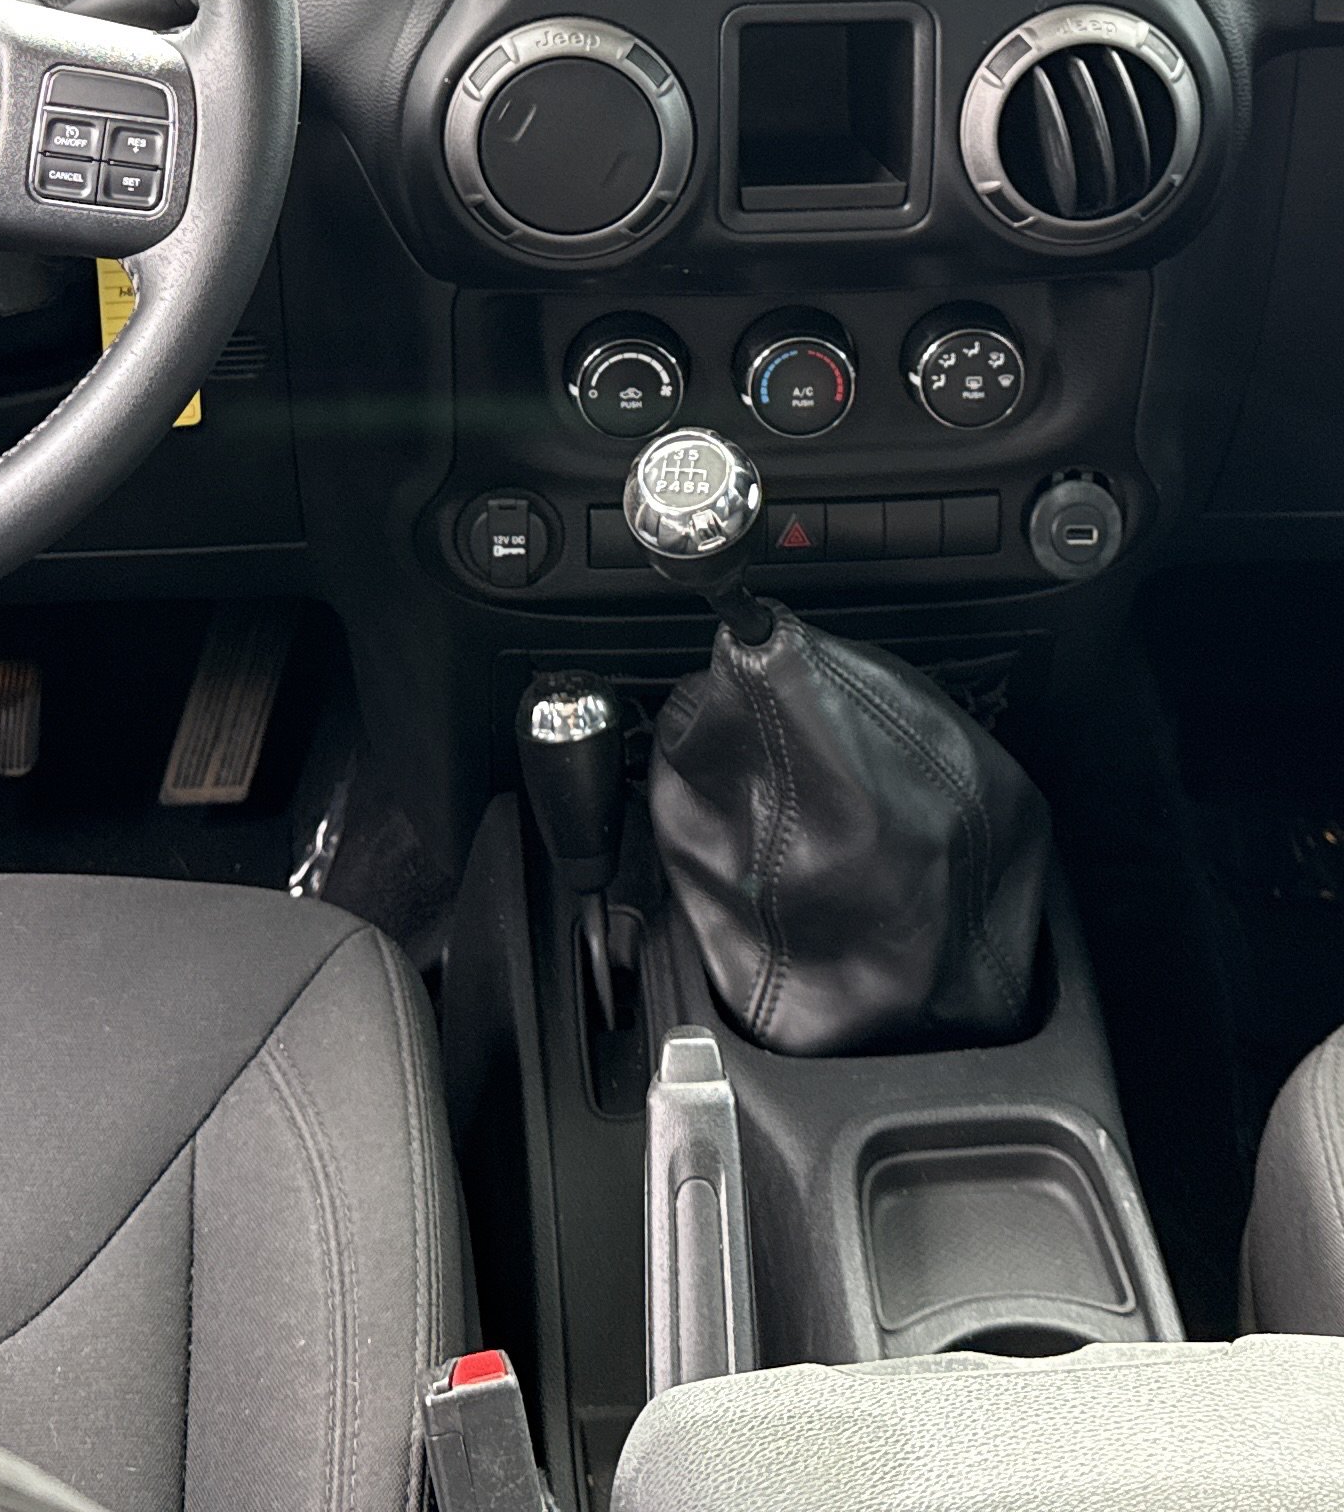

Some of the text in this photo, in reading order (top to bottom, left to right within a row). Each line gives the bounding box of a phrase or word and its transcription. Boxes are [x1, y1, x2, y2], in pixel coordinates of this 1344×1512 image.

[536, 30, 601, 53] Jeep
[53, 137, 88, 148] ON/OFF
[127, 137, 147, 148] RES
[48, 169, 84, 183] CANCEL
[122, 176, 141, 187] SET
[792, 386, 814, 398] A/C
[962, 391, 985, 399] PUSH
[619, 400, 643, 409] PUSH
[791, 399, 815, 408] PUSH
[493, 535, 509, 545] 12V
